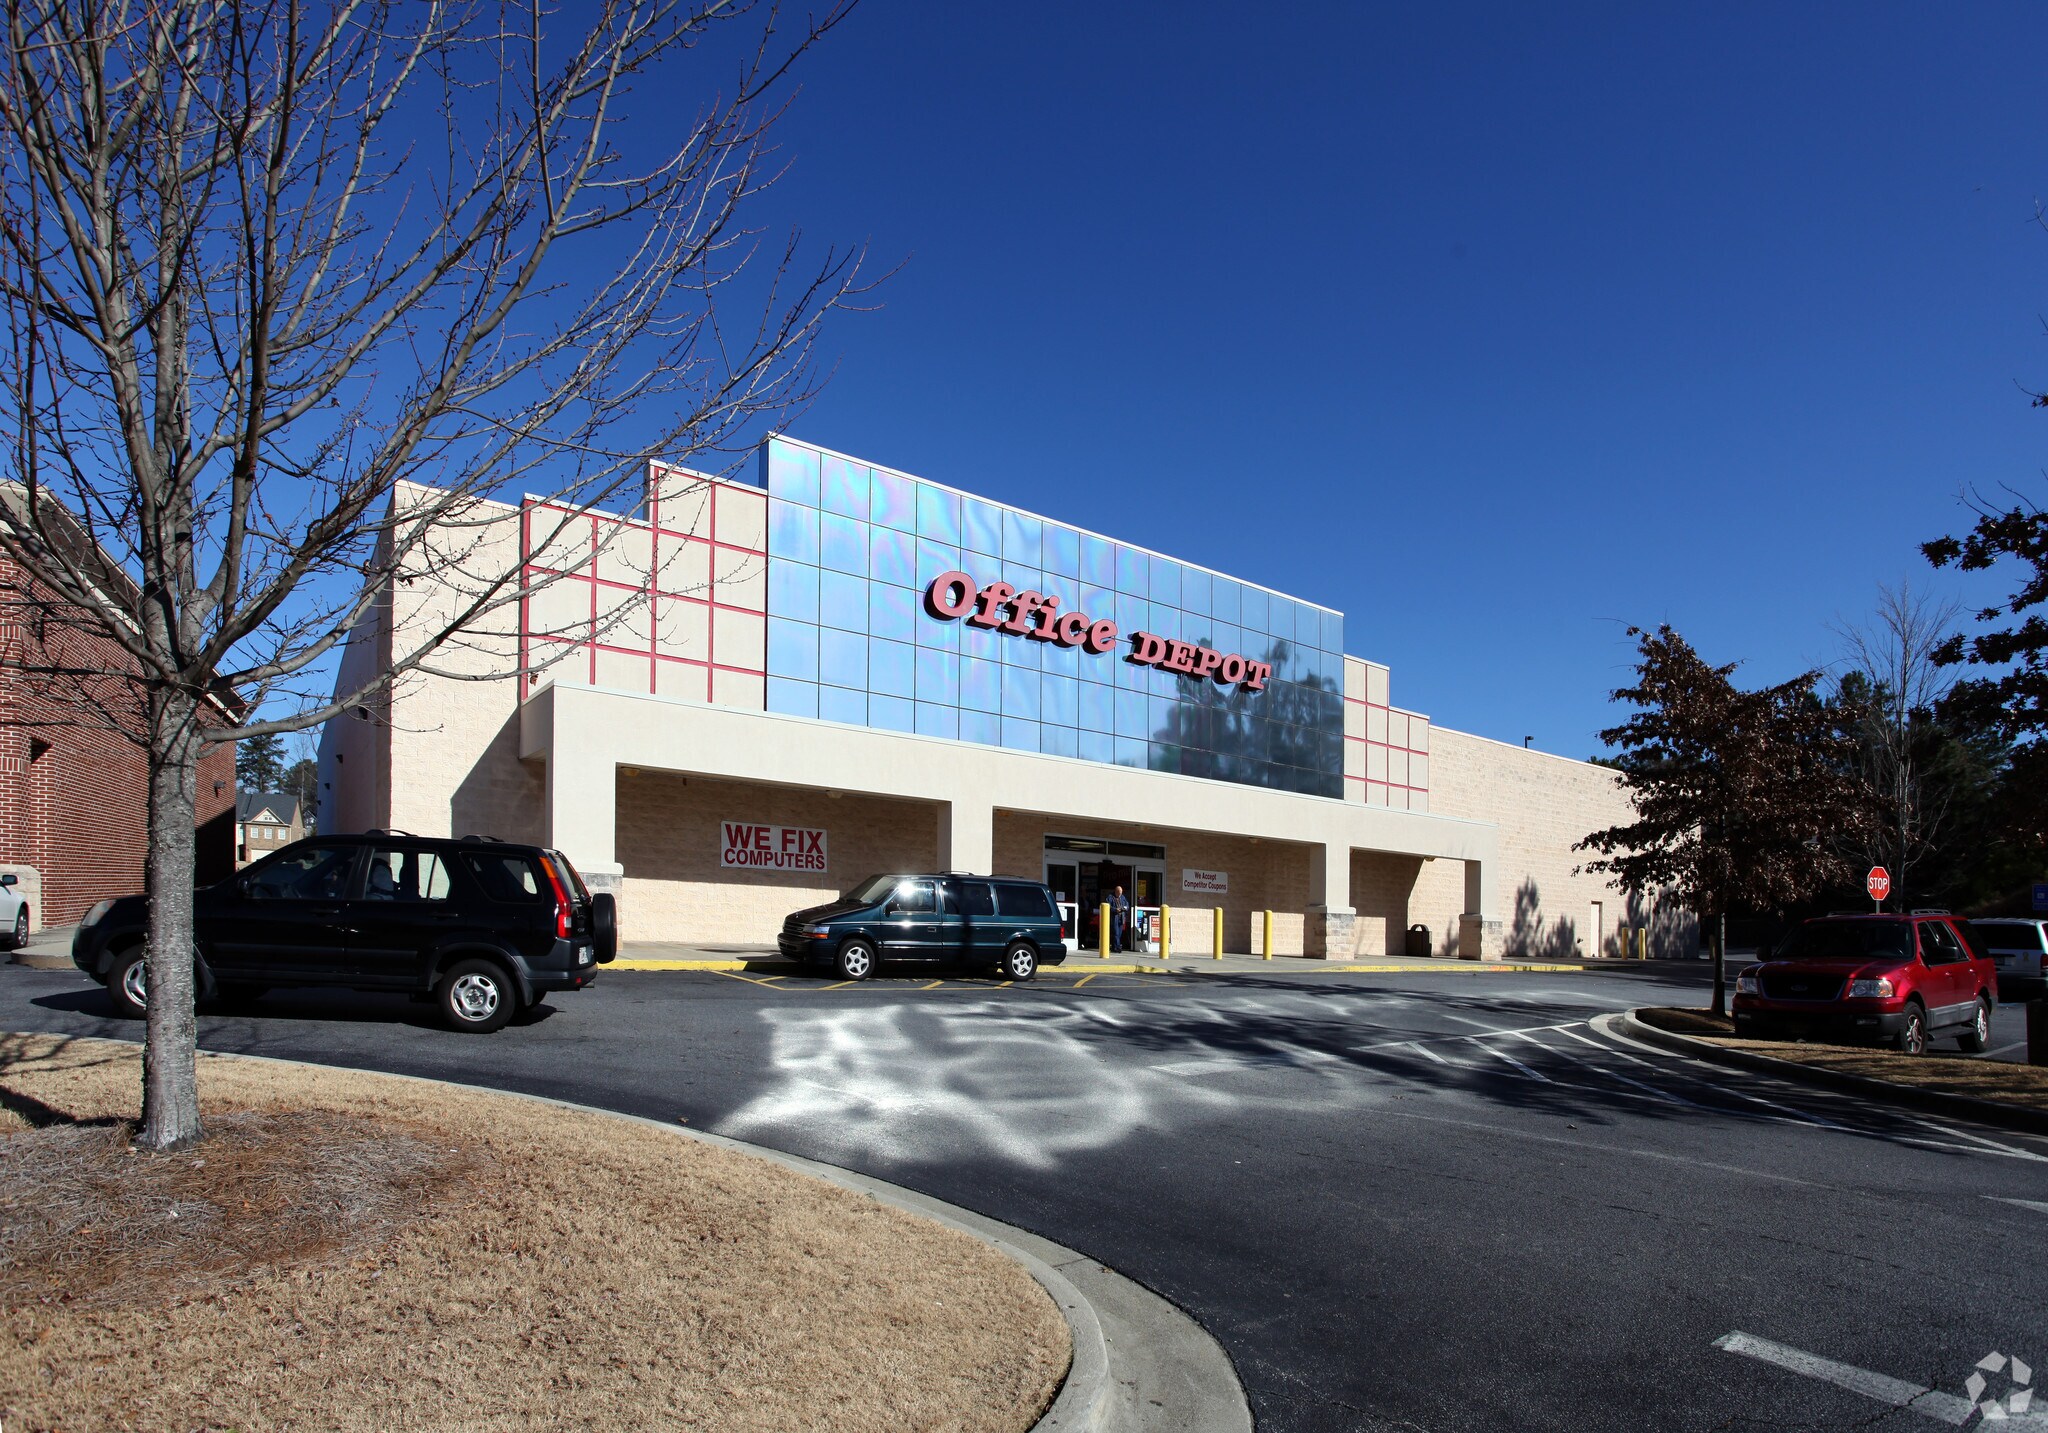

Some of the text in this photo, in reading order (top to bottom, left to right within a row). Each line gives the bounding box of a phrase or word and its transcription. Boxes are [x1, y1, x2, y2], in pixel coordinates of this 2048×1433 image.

[928, 570, 1272, 691] Office DEPOT
[725, 824, 823, 855] WE FIX
[724, 848, 825, 870] COMPUTERS
[1202, 872, 1216, 881] Accept
[1869, 877, 1888, 890] STOP
[1184, 880, 1226, 891] Competitor Coupons
